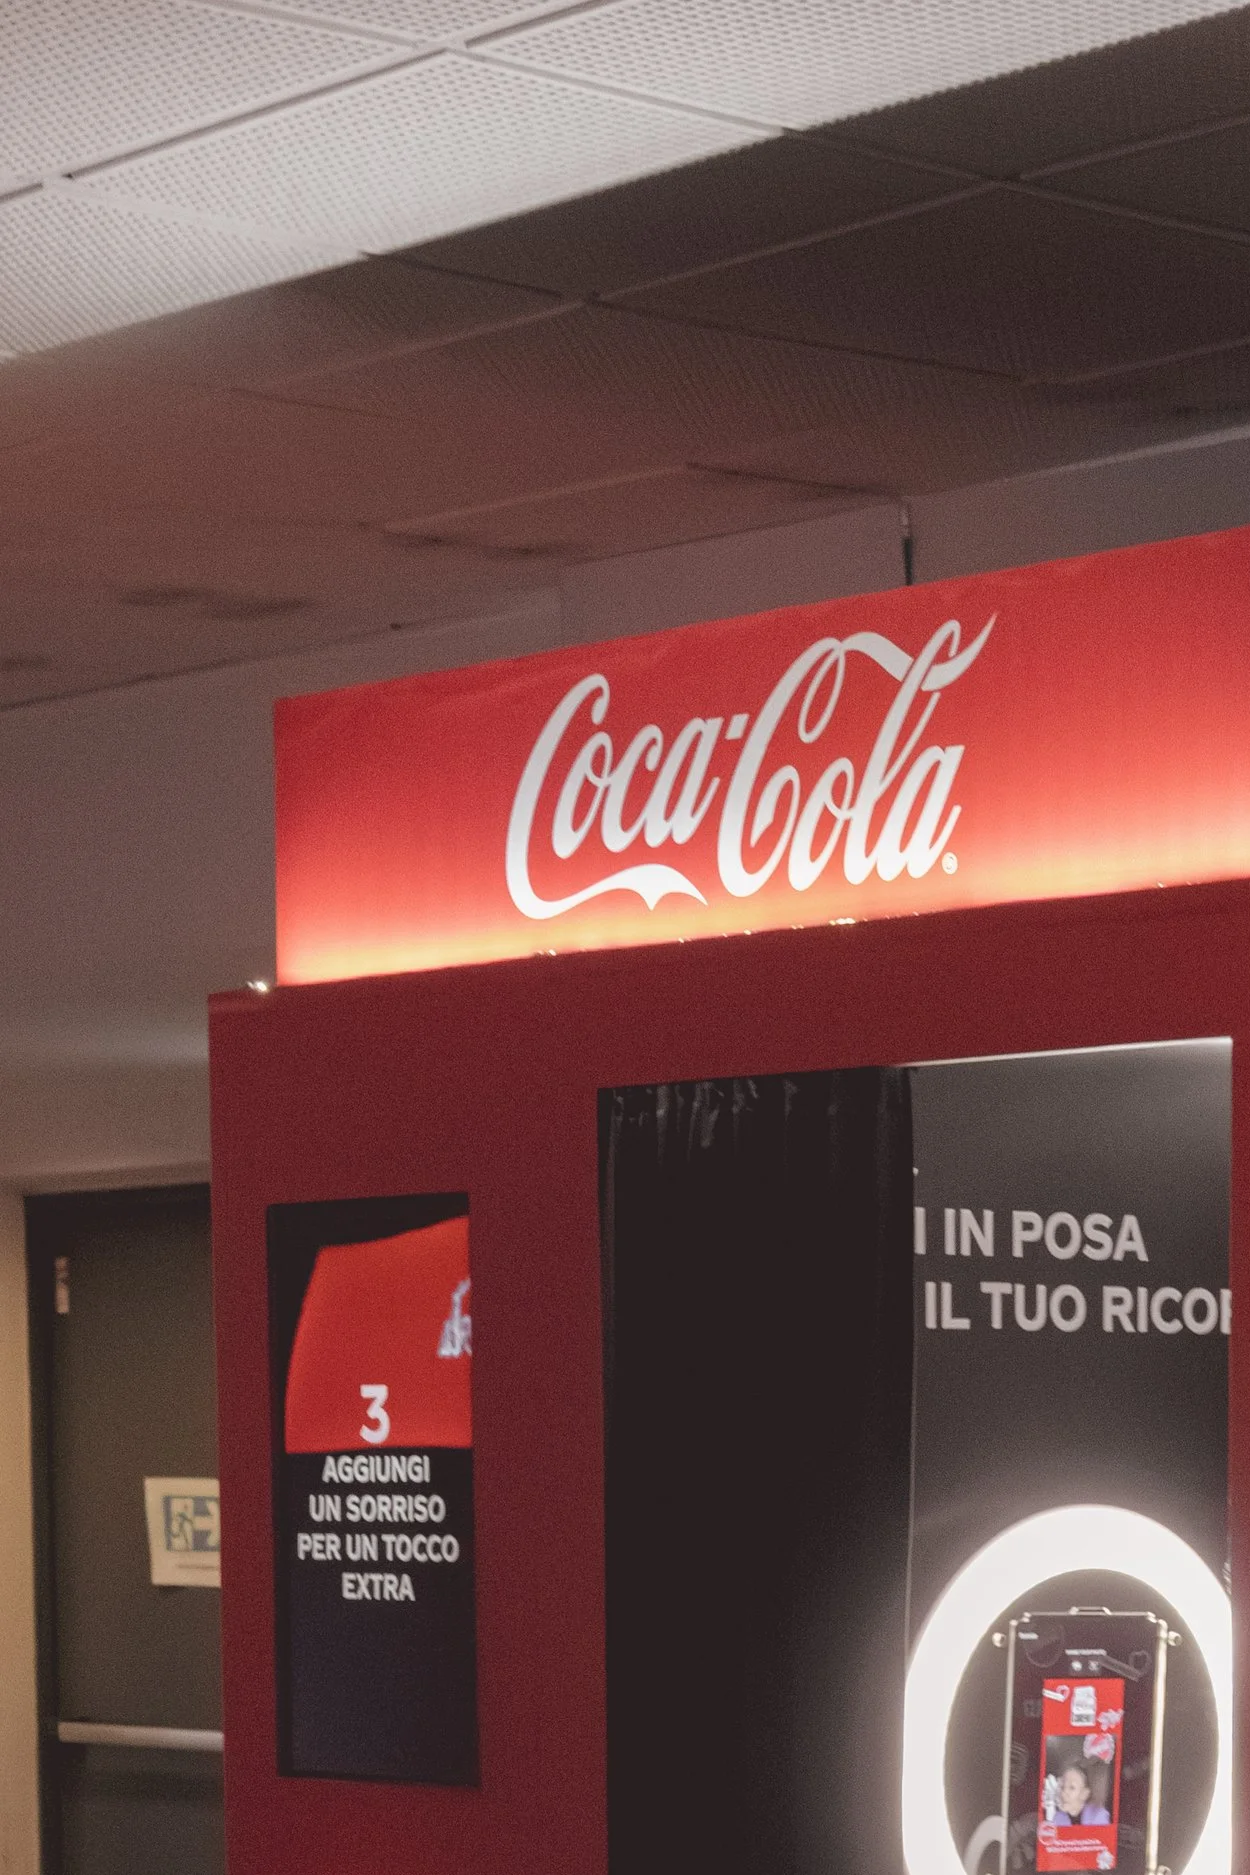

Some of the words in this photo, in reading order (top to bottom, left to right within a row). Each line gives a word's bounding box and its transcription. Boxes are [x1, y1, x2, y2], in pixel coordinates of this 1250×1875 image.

[505, 612, 997, 920] Coca-Cola
[944, 1207, 994, 1257] IN
[1011, 1209, 1149, 1262] POSA
[925, 1281, 971, 1330] IL
[980, 1281, 1087, 1332] TUO
[359, 1384, 391, 1445] 3
[321, 1456, 431, 1484] AGGIUNGI
[309, 1494, 342, 1523] UN
[346, 1494, 446, 1524] SORRISO
[297, 1533, 342, 1562] PER
[345, 1533, 378, 1562] UN
[381, 1533, 460, 1564] TOCCO
[341, 1573, 416, 1602] EXTRA
